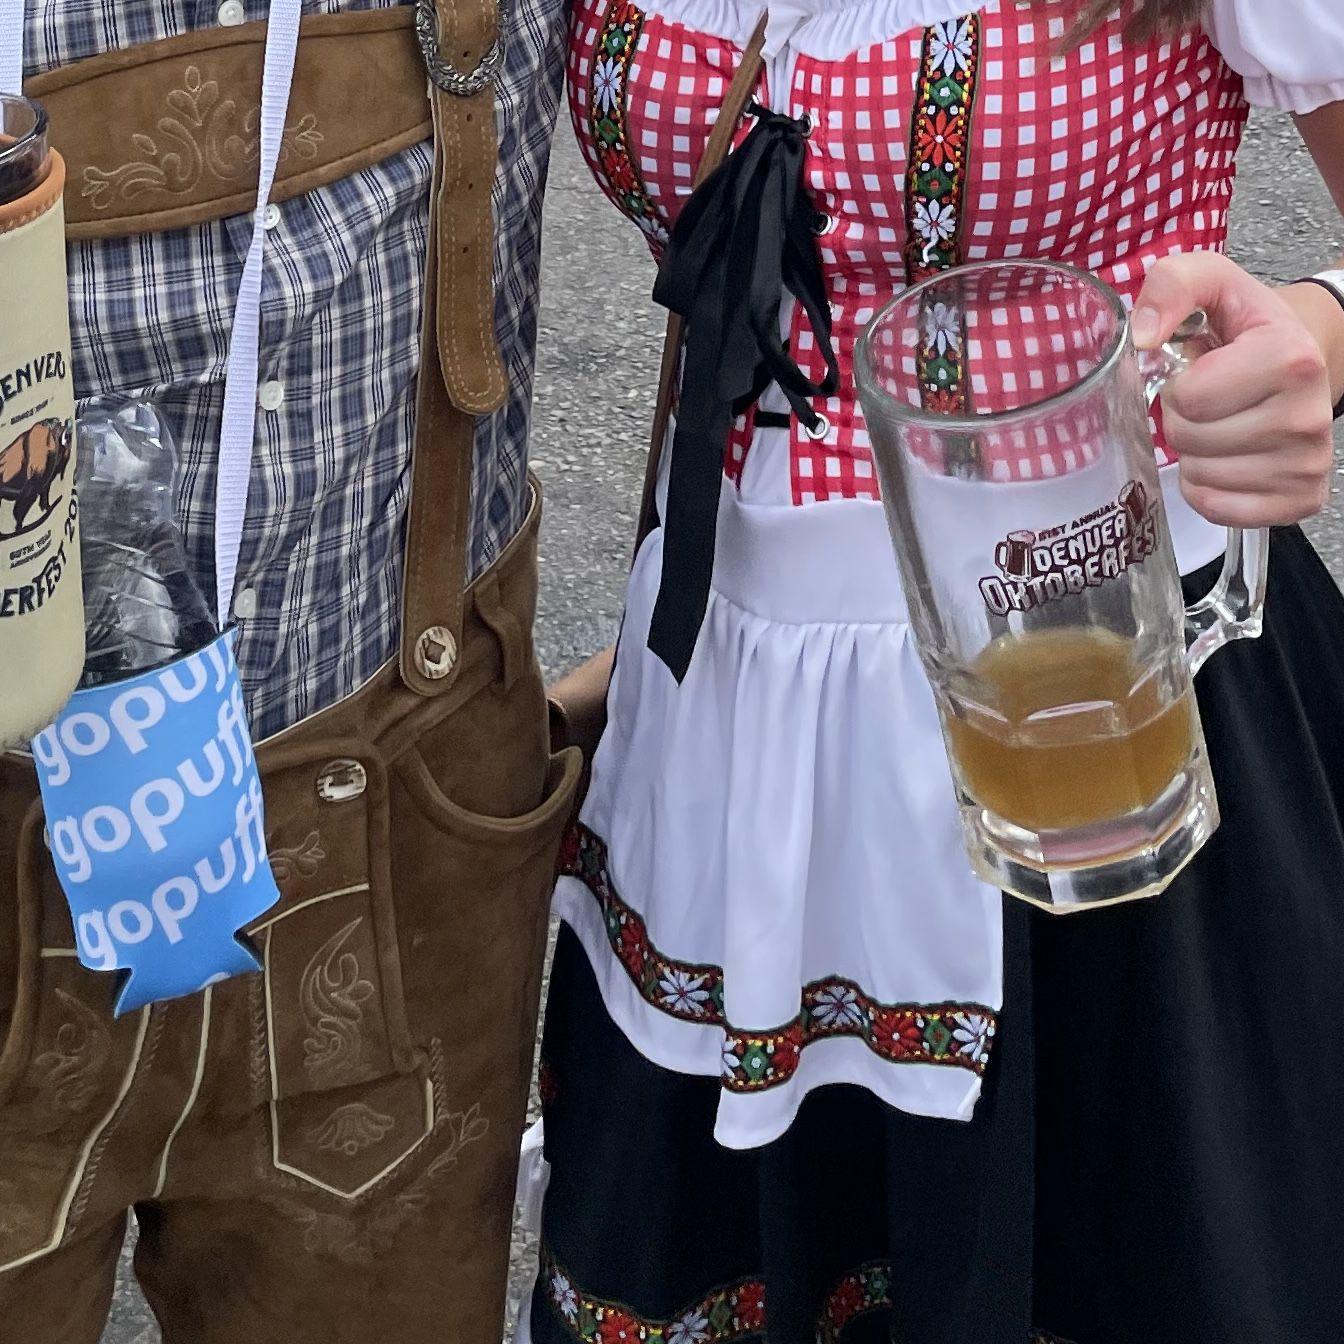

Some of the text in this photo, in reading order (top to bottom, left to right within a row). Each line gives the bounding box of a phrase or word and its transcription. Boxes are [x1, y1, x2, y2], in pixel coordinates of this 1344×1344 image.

[1031, 510, 1129, 573] DENVER
[53, 681, 253, 885] gopuff
[76, 776, 267, 972] gopuff
